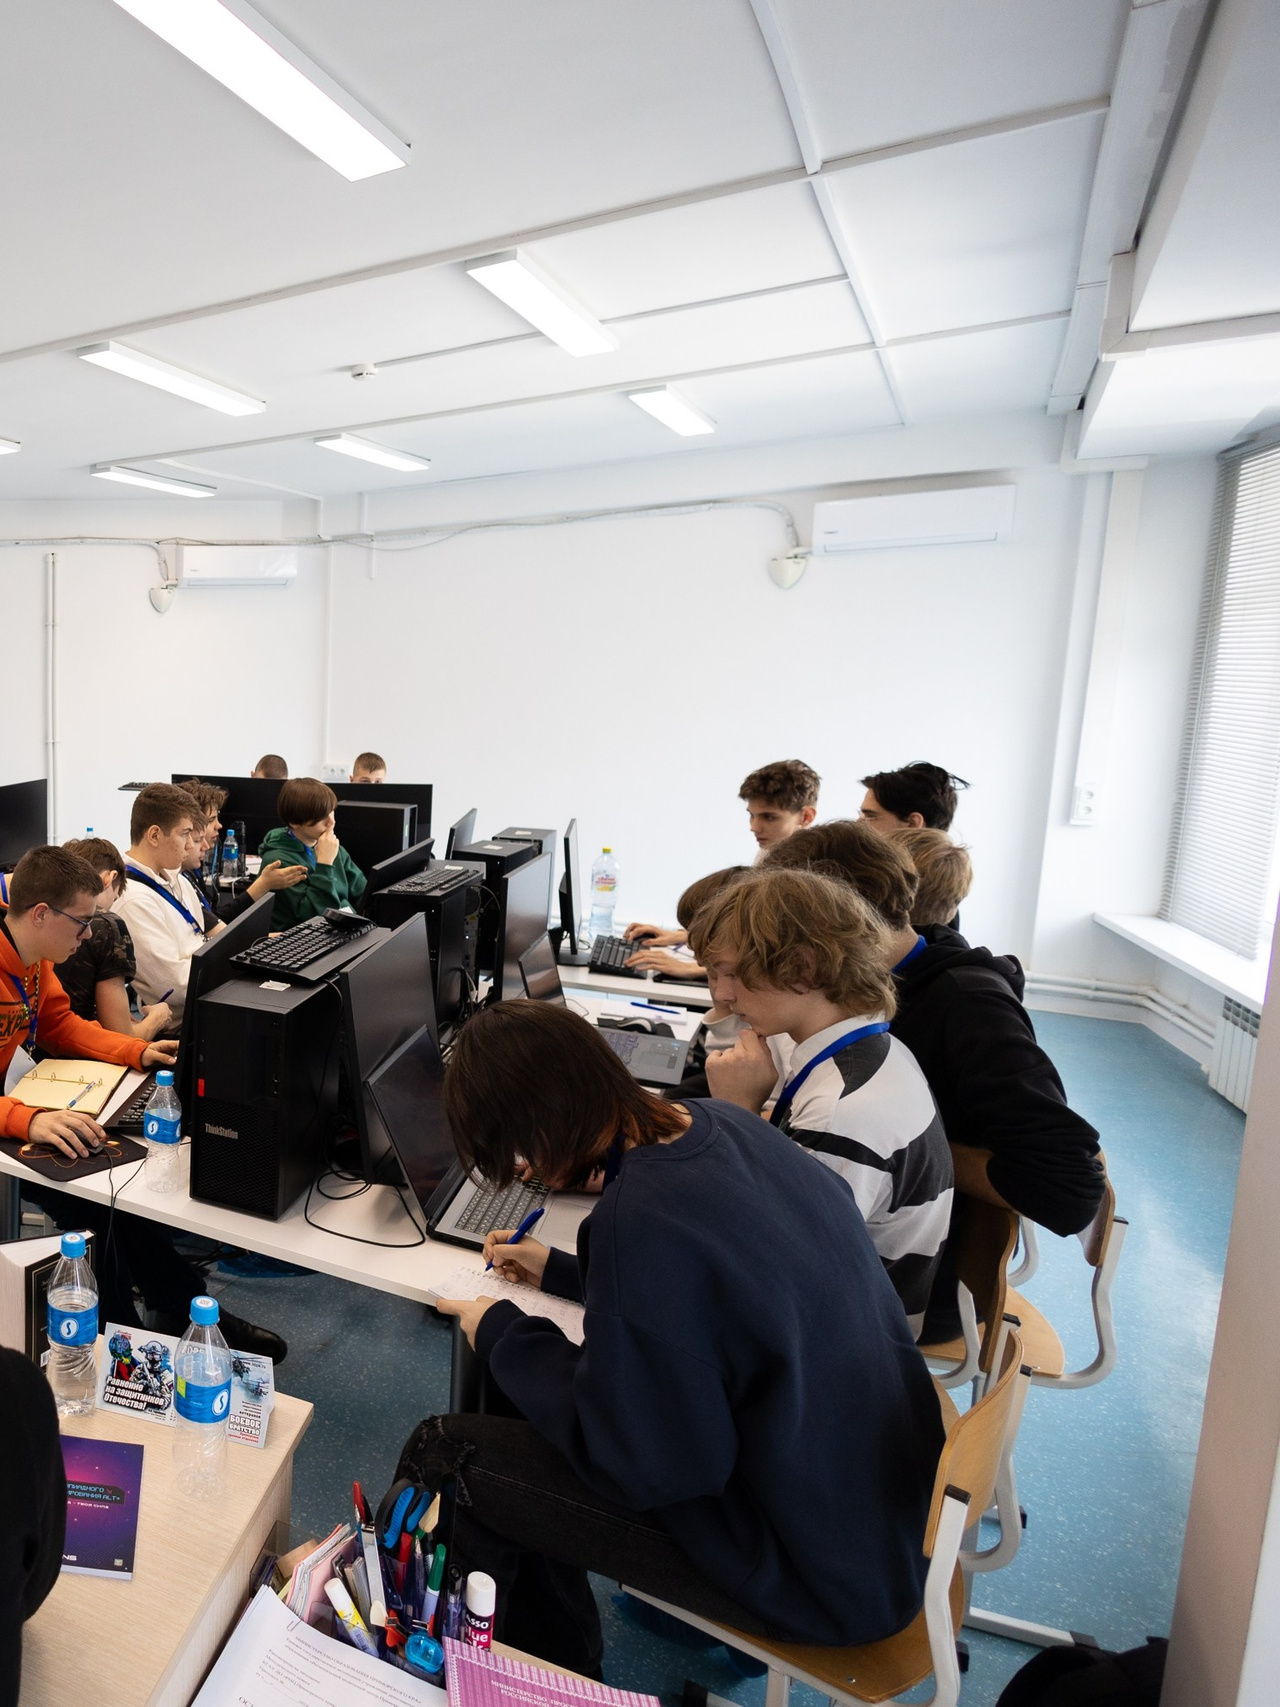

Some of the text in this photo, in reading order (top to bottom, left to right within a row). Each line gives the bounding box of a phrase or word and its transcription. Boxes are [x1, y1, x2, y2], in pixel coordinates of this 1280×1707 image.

[107, 1376, 144, 1392] Равнение
[104, 1394, 147, 1410] Отечества!
[105, 1385, 165, 1406] на защитников
[229, 1423, 260, 1436] БРАТСТВО
[230, 1414, 261, 1429] БОЕВОЕ
[491, 1680, 548, 1702] МИНИСТЕРСТВО
